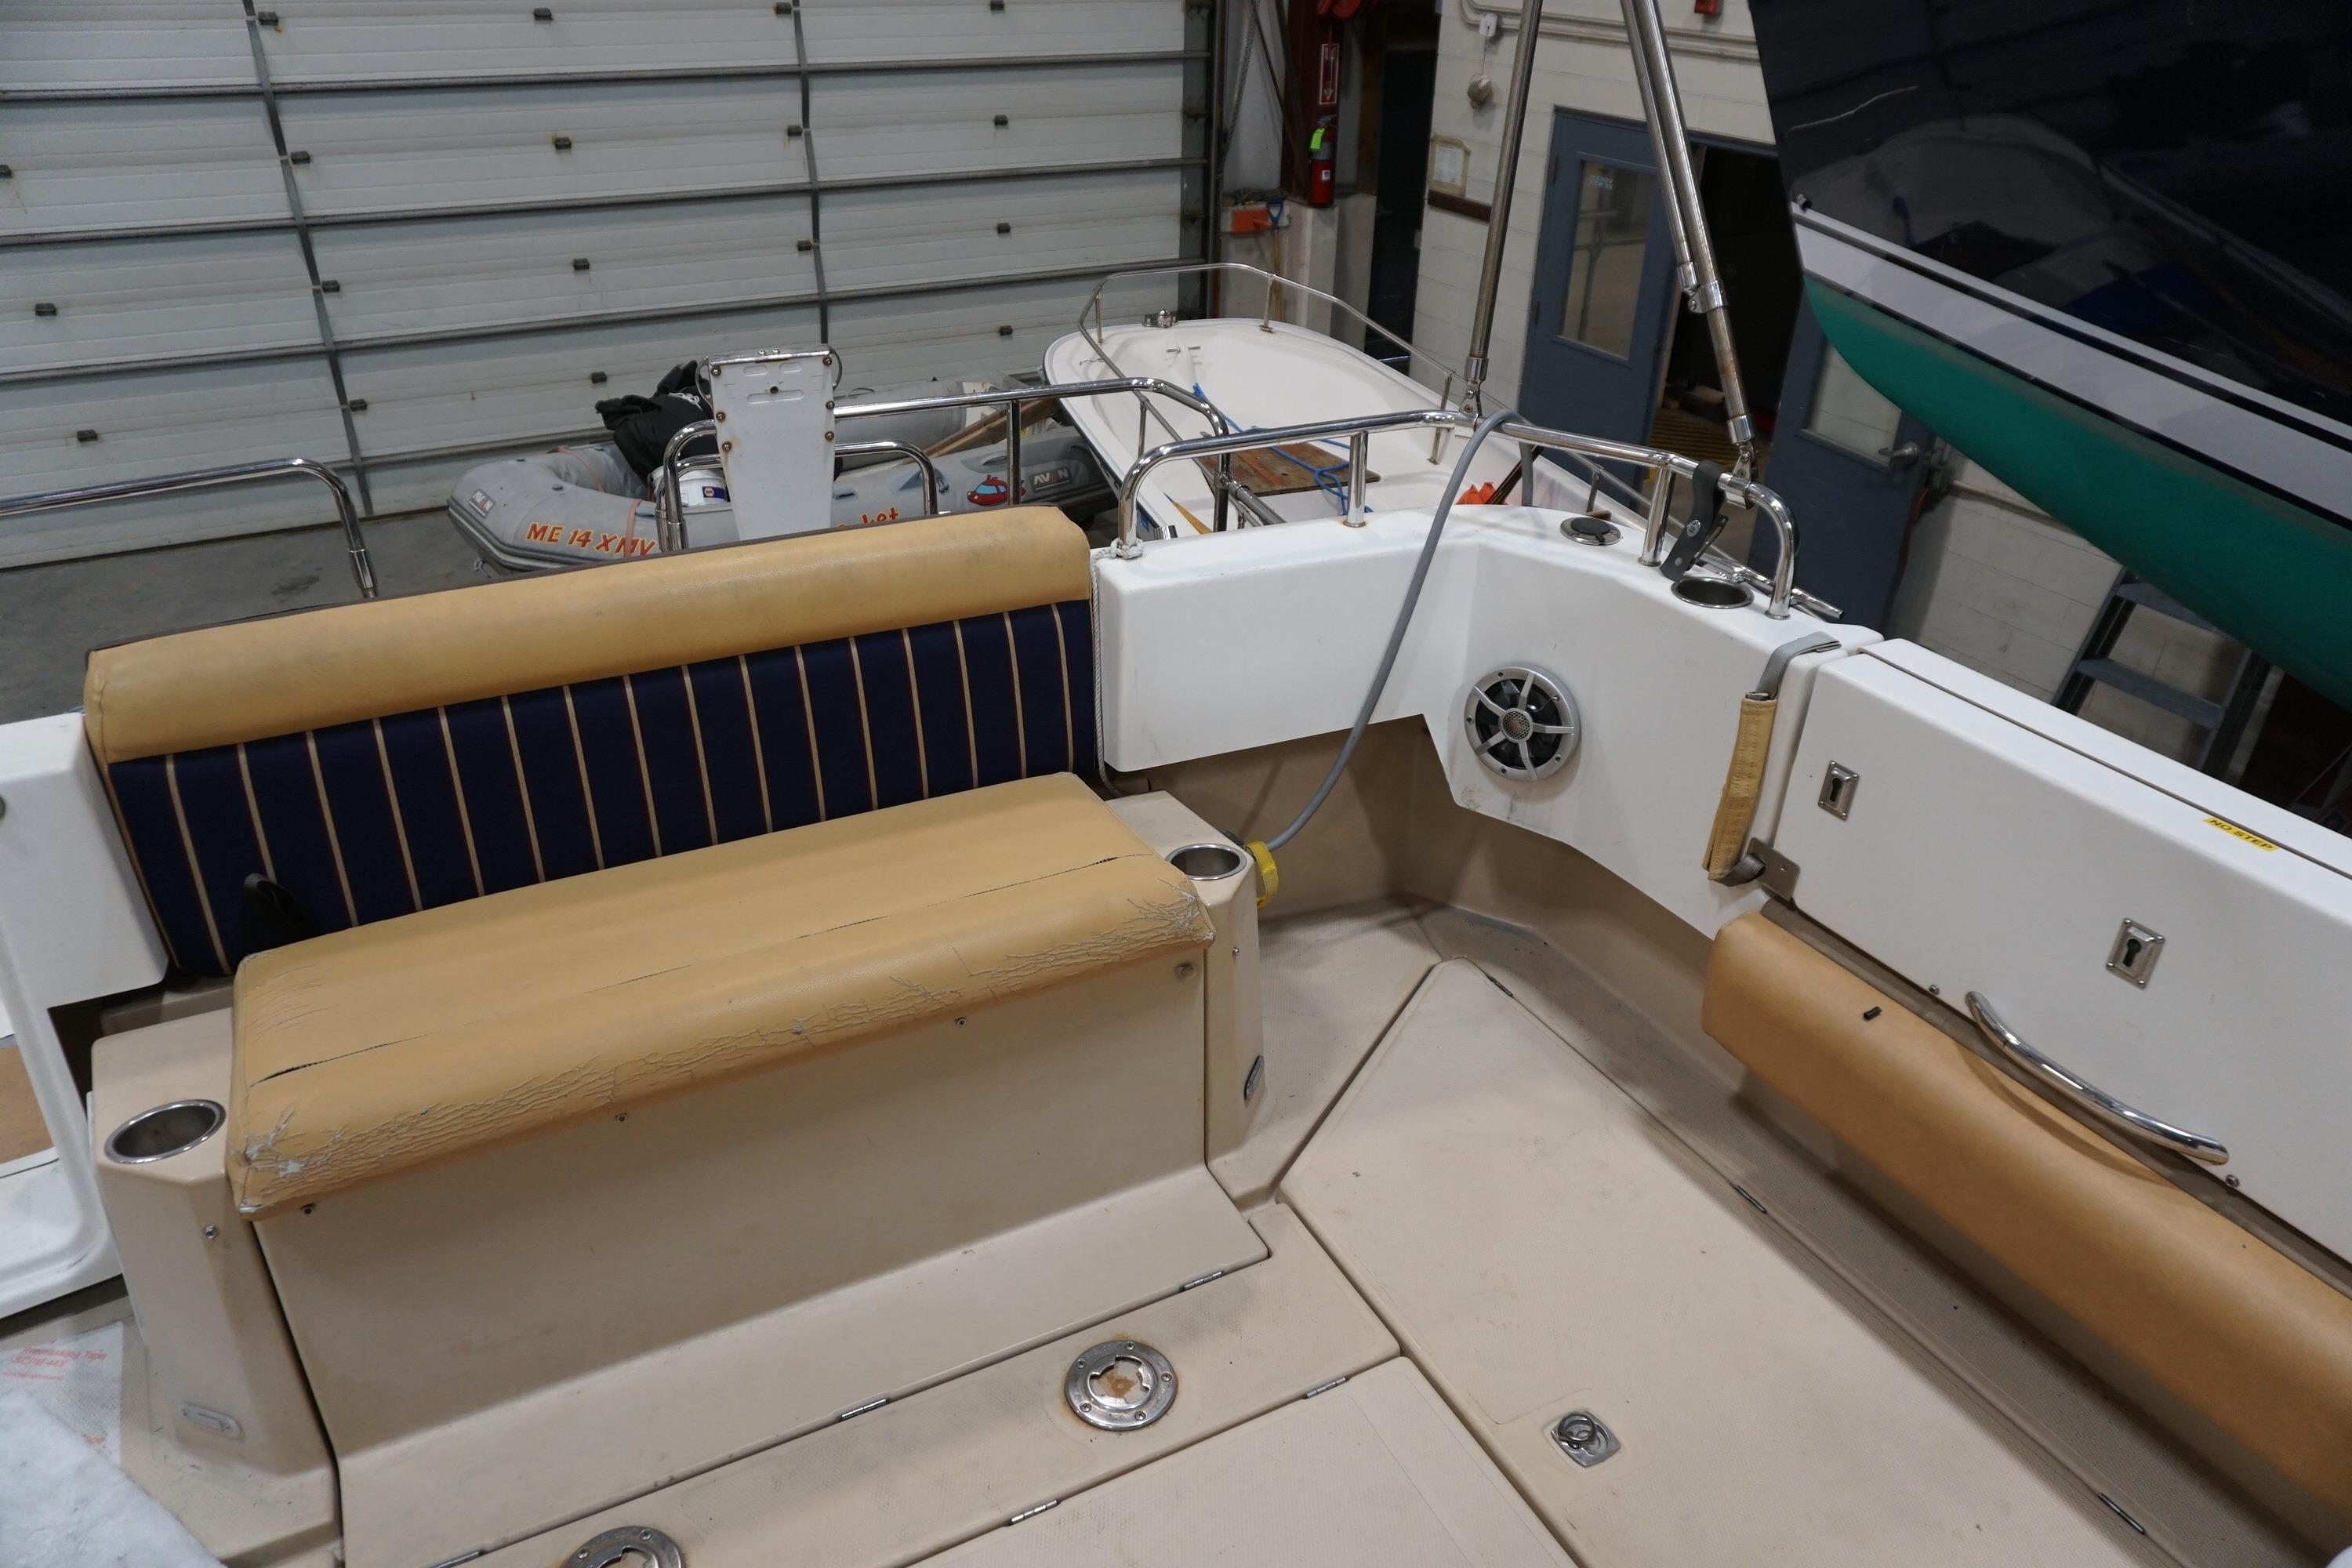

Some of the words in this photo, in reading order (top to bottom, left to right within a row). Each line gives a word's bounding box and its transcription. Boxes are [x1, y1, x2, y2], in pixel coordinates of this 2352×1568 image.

[527, 523, 564, 543] ME
[567, 528, 593, 548] 14
[595, 533, 657, 556] XMV
[2210, 820, 2232, 830] NO
[2234, 831, 2273, 848] STEP
